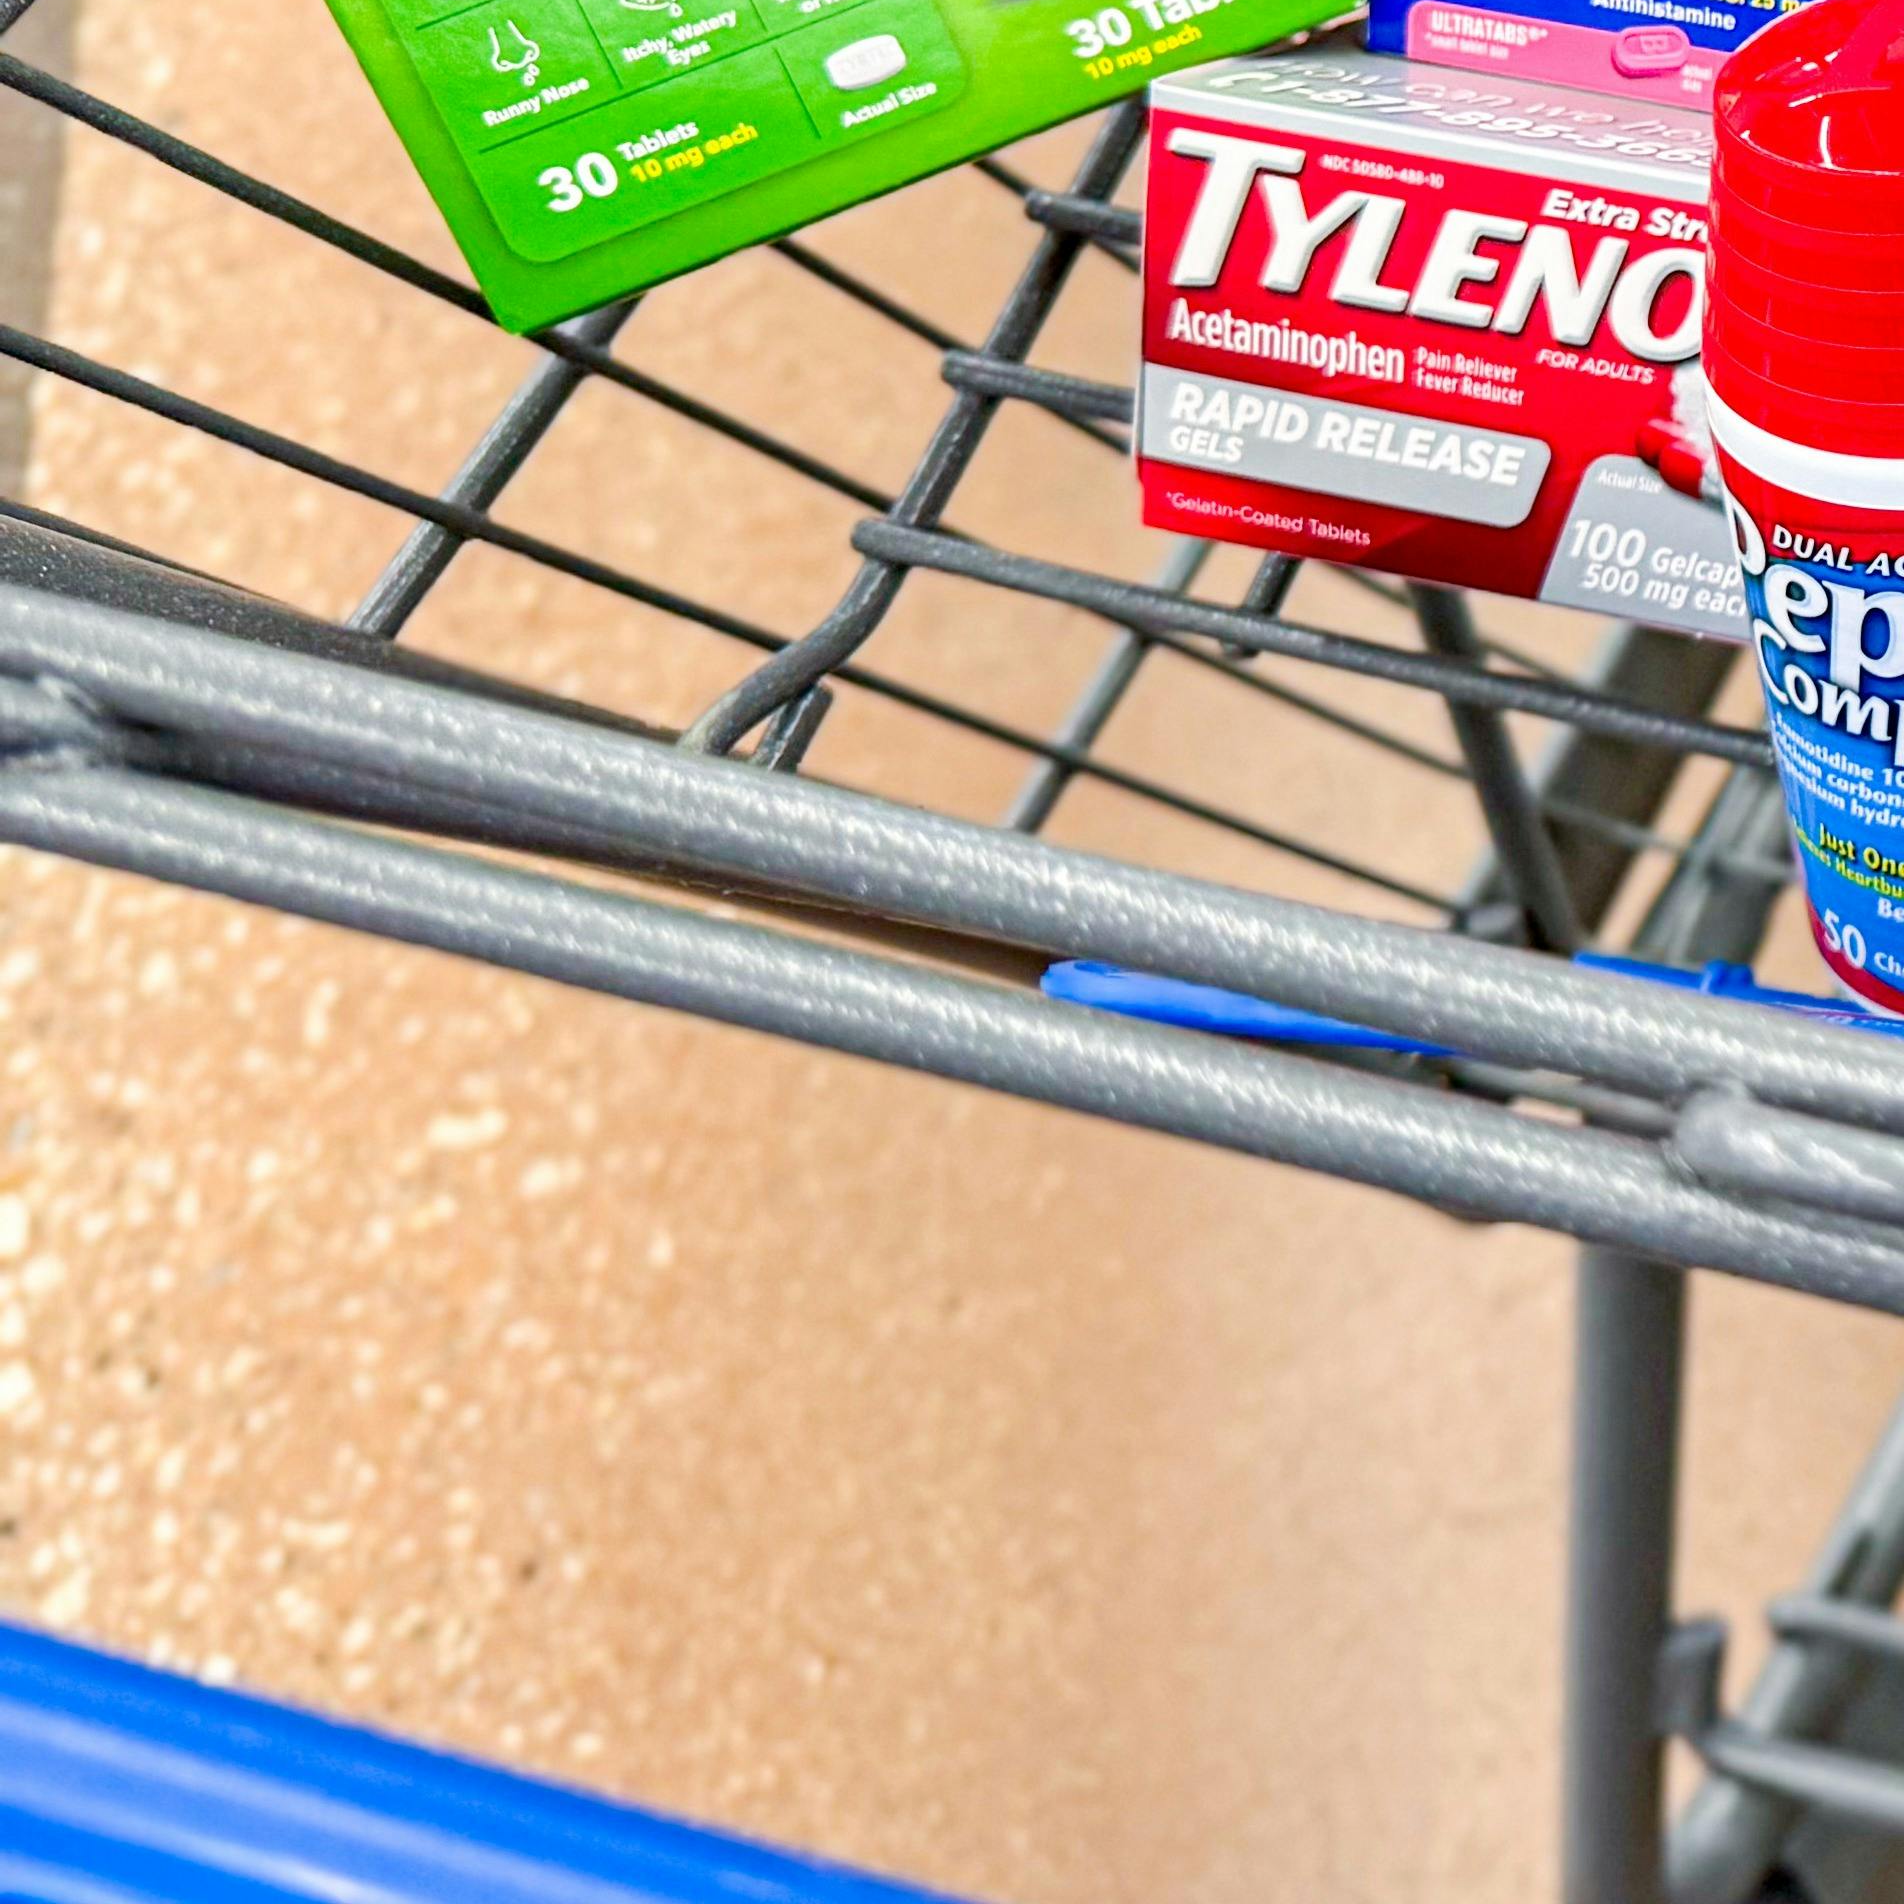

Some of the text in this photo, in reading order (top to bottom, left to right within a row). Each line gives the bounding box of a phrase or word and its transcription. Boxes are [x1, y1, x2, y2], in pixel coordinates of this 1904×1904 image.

[1066, 14, 1133, 60] 30
[482, 78, 591, 128] Runny Nose
[842, 80, 937, 129] Actual Size
[1542, 190, 1641, 231] Extra
[1169, 299, 1405, 383] Acetaminophen
[1416, 347, 1518, 382] Pain Reliever
[1415, 370, 1524, 407] Fever Reducer
[1168, 428, 1245, 463] GELS
[1171, 383, 1525, 486] RAPID RELEASE
[1569, 520, 1647, 563] 100
[1772, 524, 1853, 572] DUAL
[1582, 563, 1688, 612] 500 mg
[1818, 825, 1857, 859] Just
[1824, 909, 1865, 970] 50
